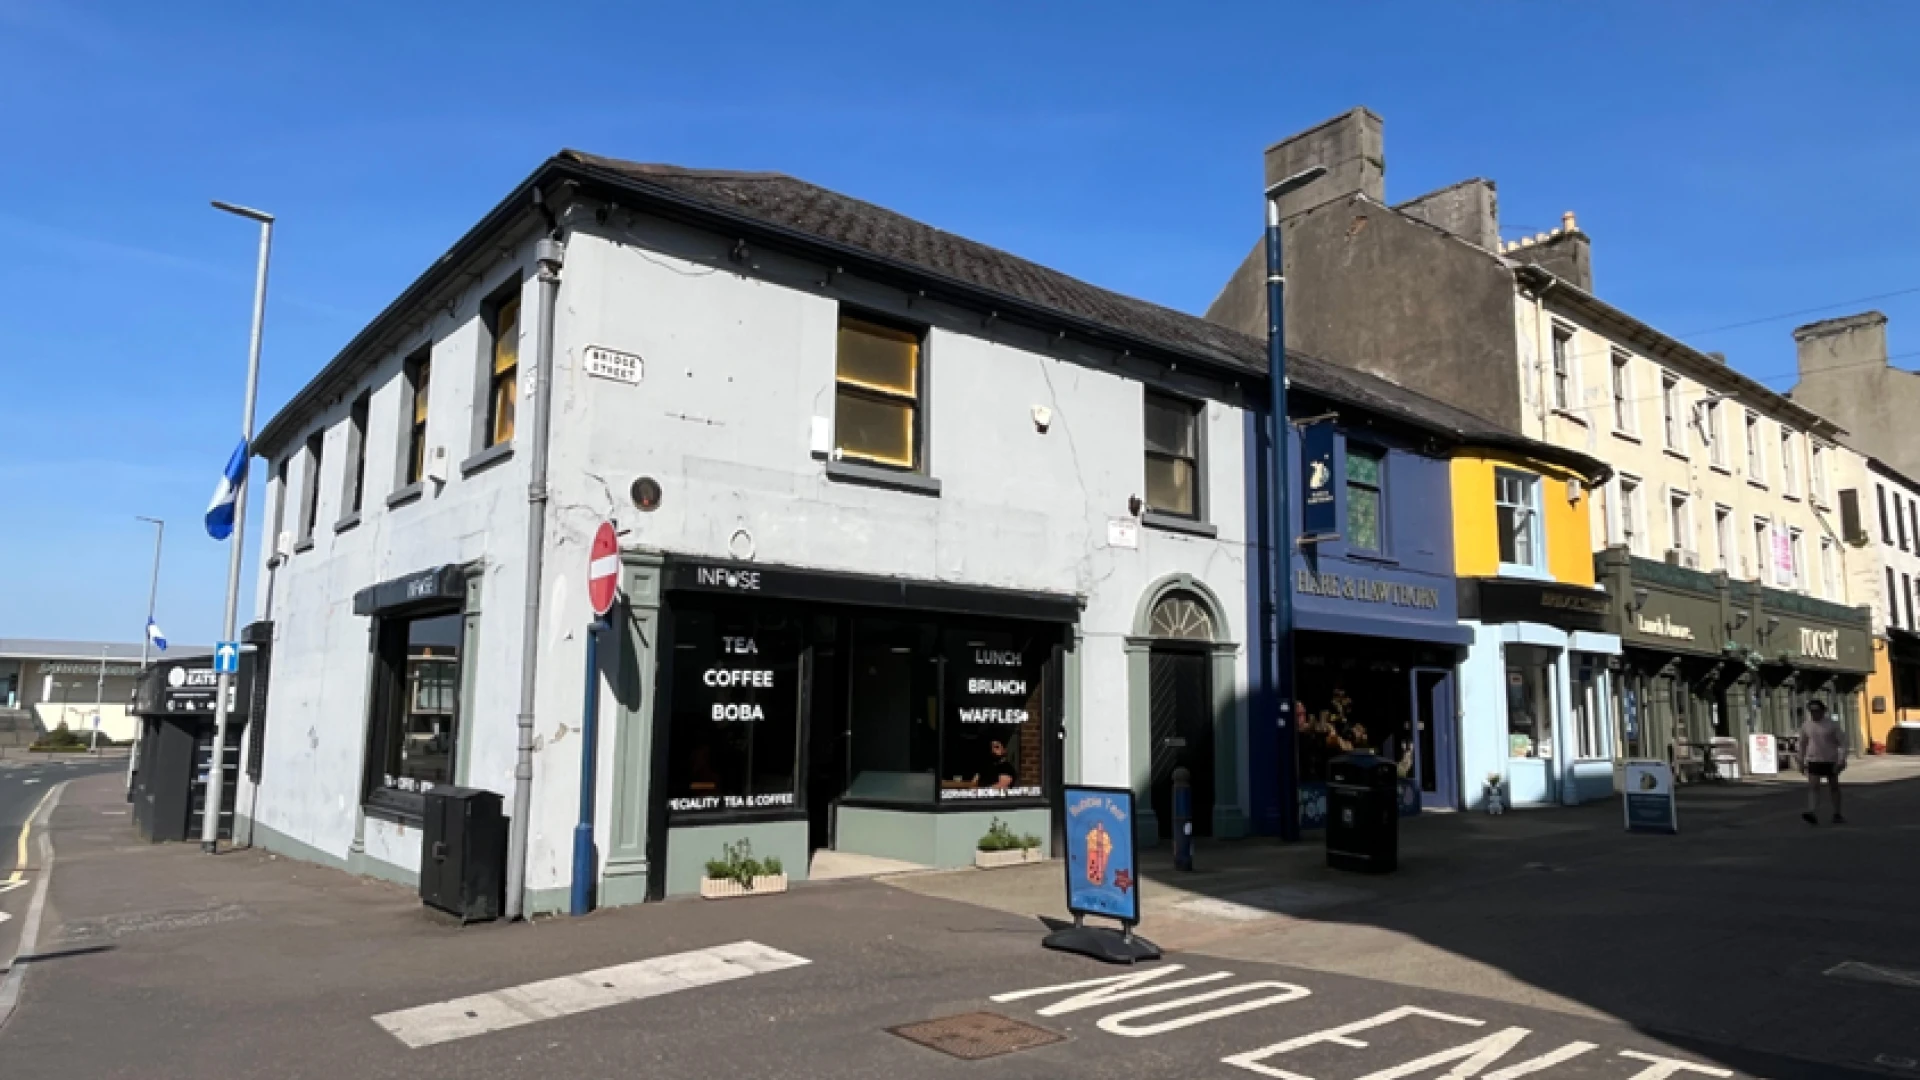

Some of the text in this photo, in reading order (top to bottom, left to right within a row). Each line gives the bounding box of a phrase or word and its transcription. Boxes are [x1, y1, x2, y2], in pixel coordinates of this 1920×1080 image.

[593, 351, 636, 368] BRIDGE
[593, 363, 636, 379] STREET
[698, 568, 760, 590] INFUSE
[1297, 570, 1438, 610] HARE & HAWTHORN
[723, 636, 758, 653] TEA
[975, 650, 1022, 667] LUNCH
[703, 669, 774, 687] COFFEE
[968, 678, 1026, 696] BRUNCH
[711, 703, 765, 721] BOBA
[959, 707, 1021, 723] WAFFLES
[667, 793, 793, 810] PECIALITY TEA & COFFEE
[987, 963, 1313, 1037] NO
